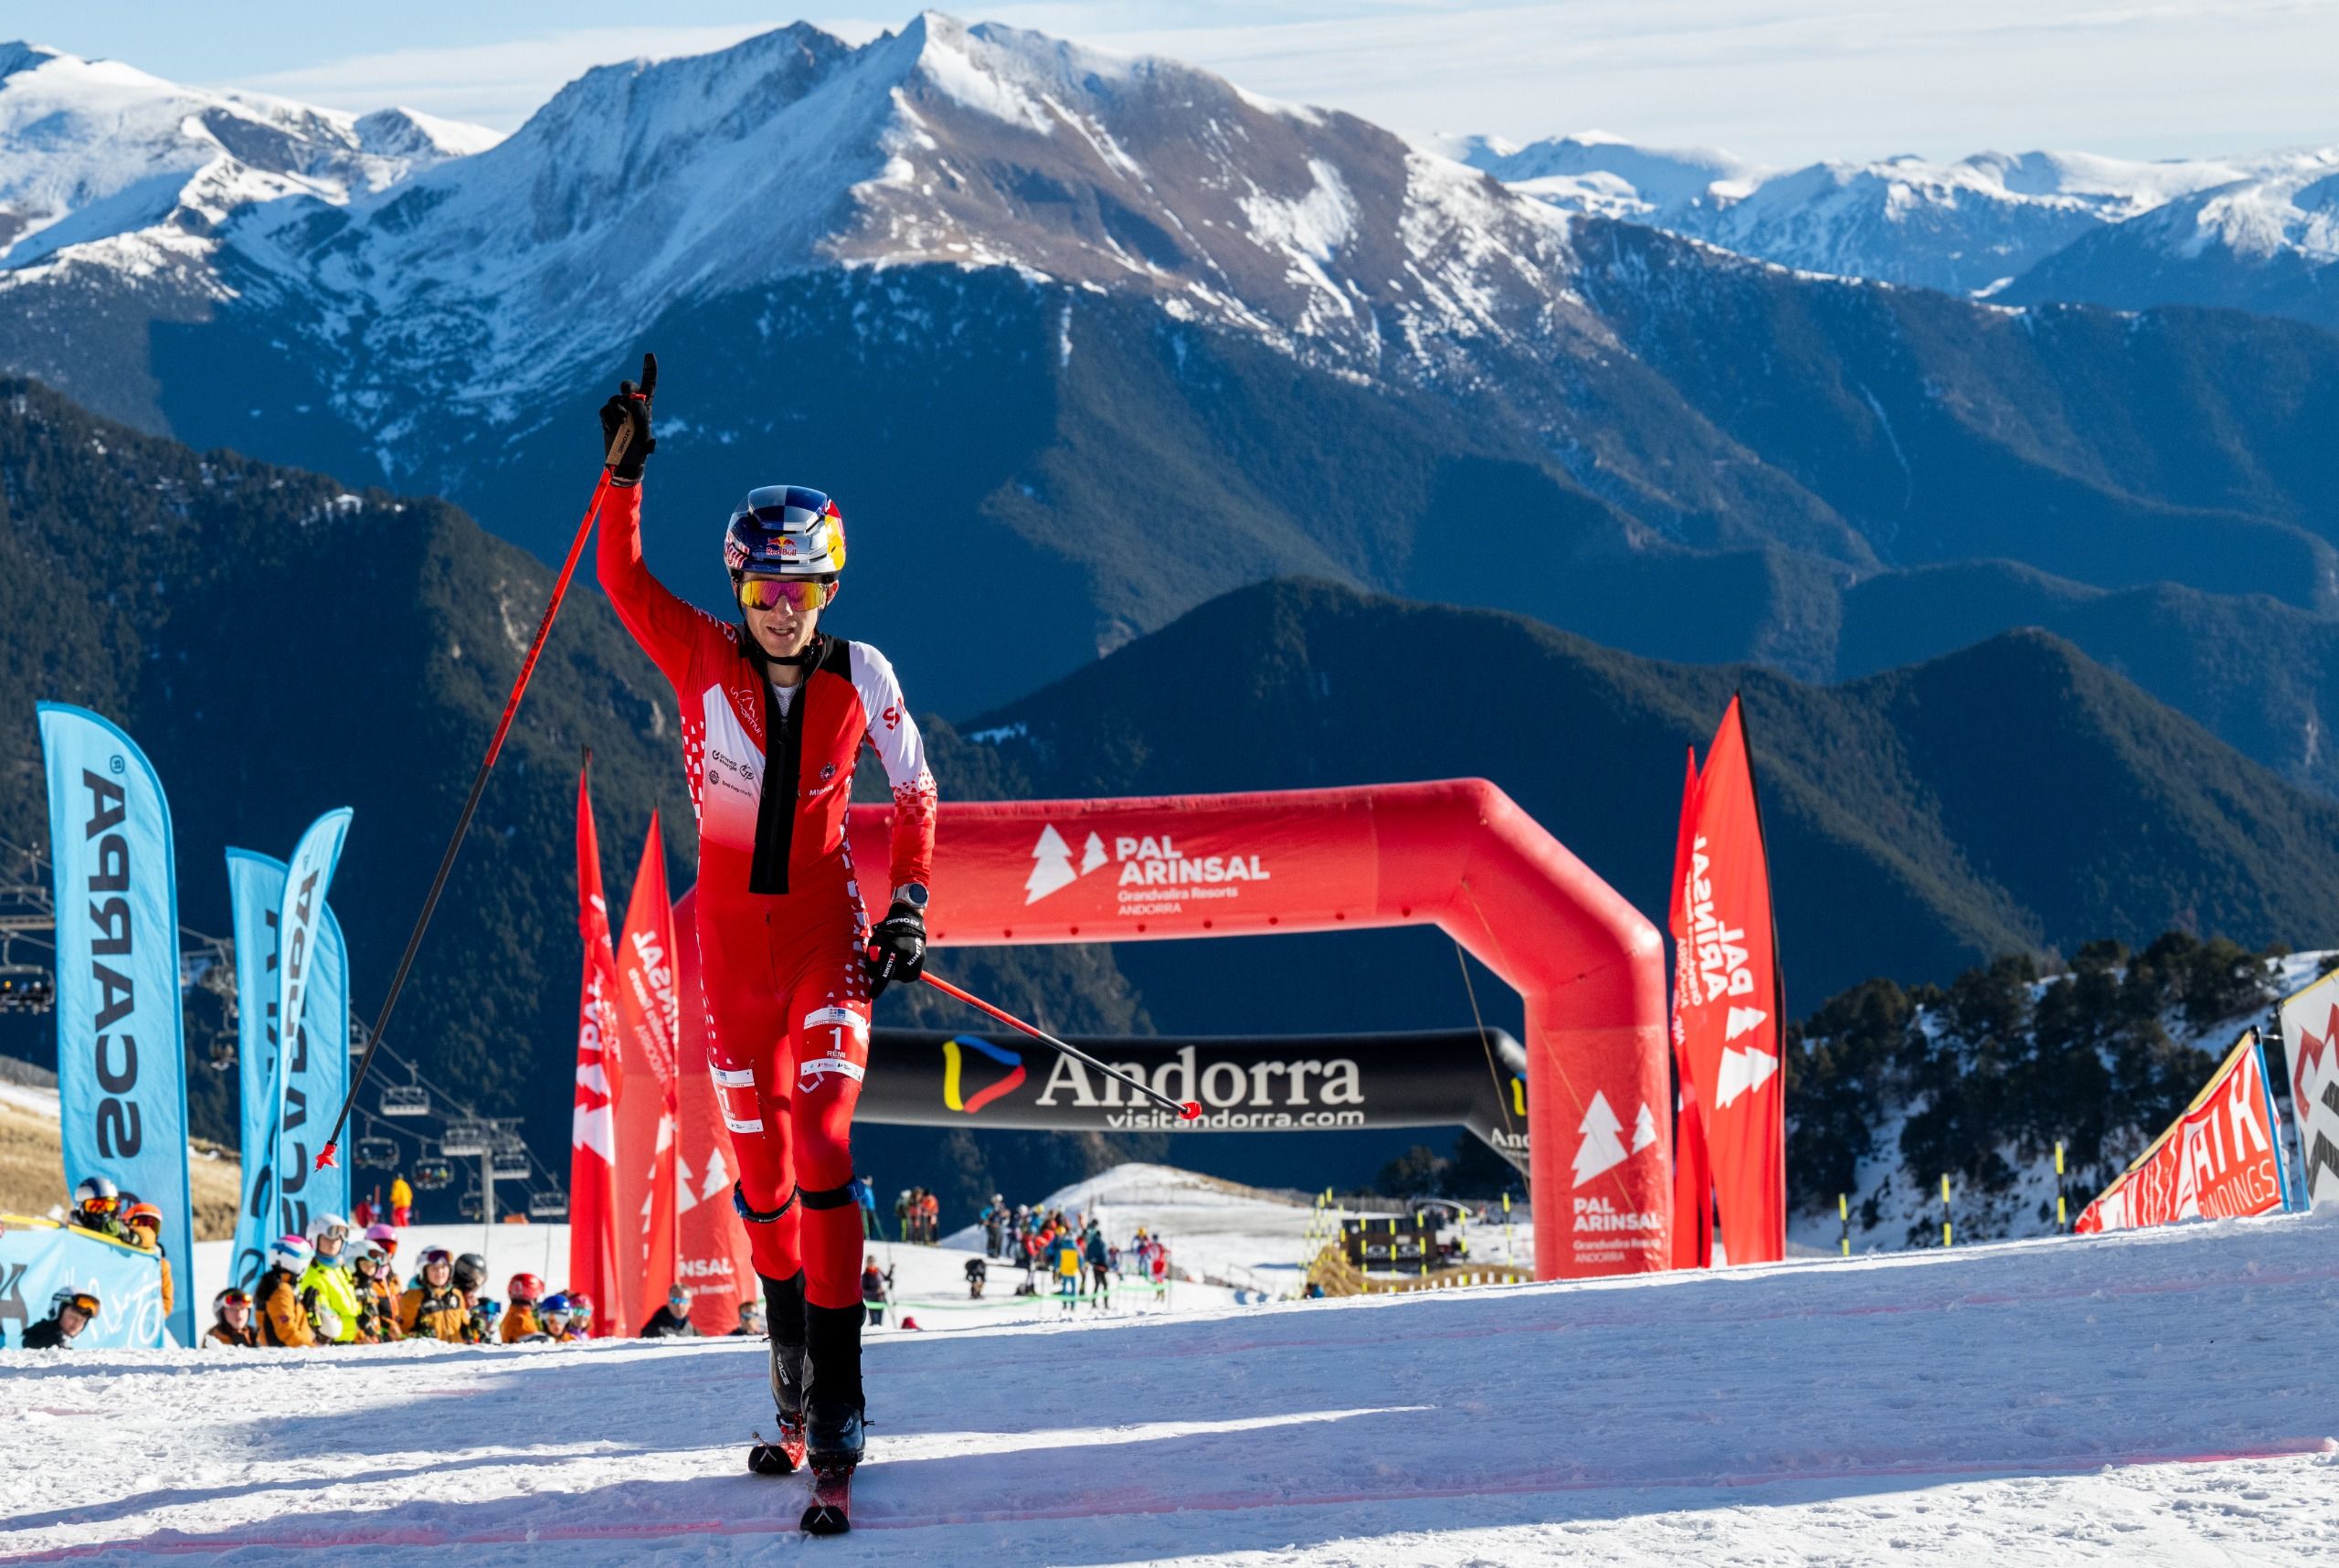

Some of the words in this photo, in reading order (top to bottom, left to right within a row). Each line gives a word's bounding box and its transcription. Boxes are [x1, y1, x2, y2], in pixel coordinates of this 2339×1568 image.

[767, 547, 782, 556] Red
[782, 547, 797, 556] Bull
[1116, 835, 1183, 862] PAL
[1117, 855, 1272, 886] ARINSAL
[1117, 888, 1189, 903] Grandvalira
[1191, 886, 1239, 900] Resorts
[1118, 902, 1182, 916] ANDORRA
[885, 916, 920, 927] ATOMIC
[829, 1026, 841, 1051] 1
[1034, 1044, 1365, 1108] Andorra
[719, 1088, 730, 1110] 1
[1573, 1196, 1615, 1214] PAL
[1572, 1213, 1662, 1233] ARINSAL
